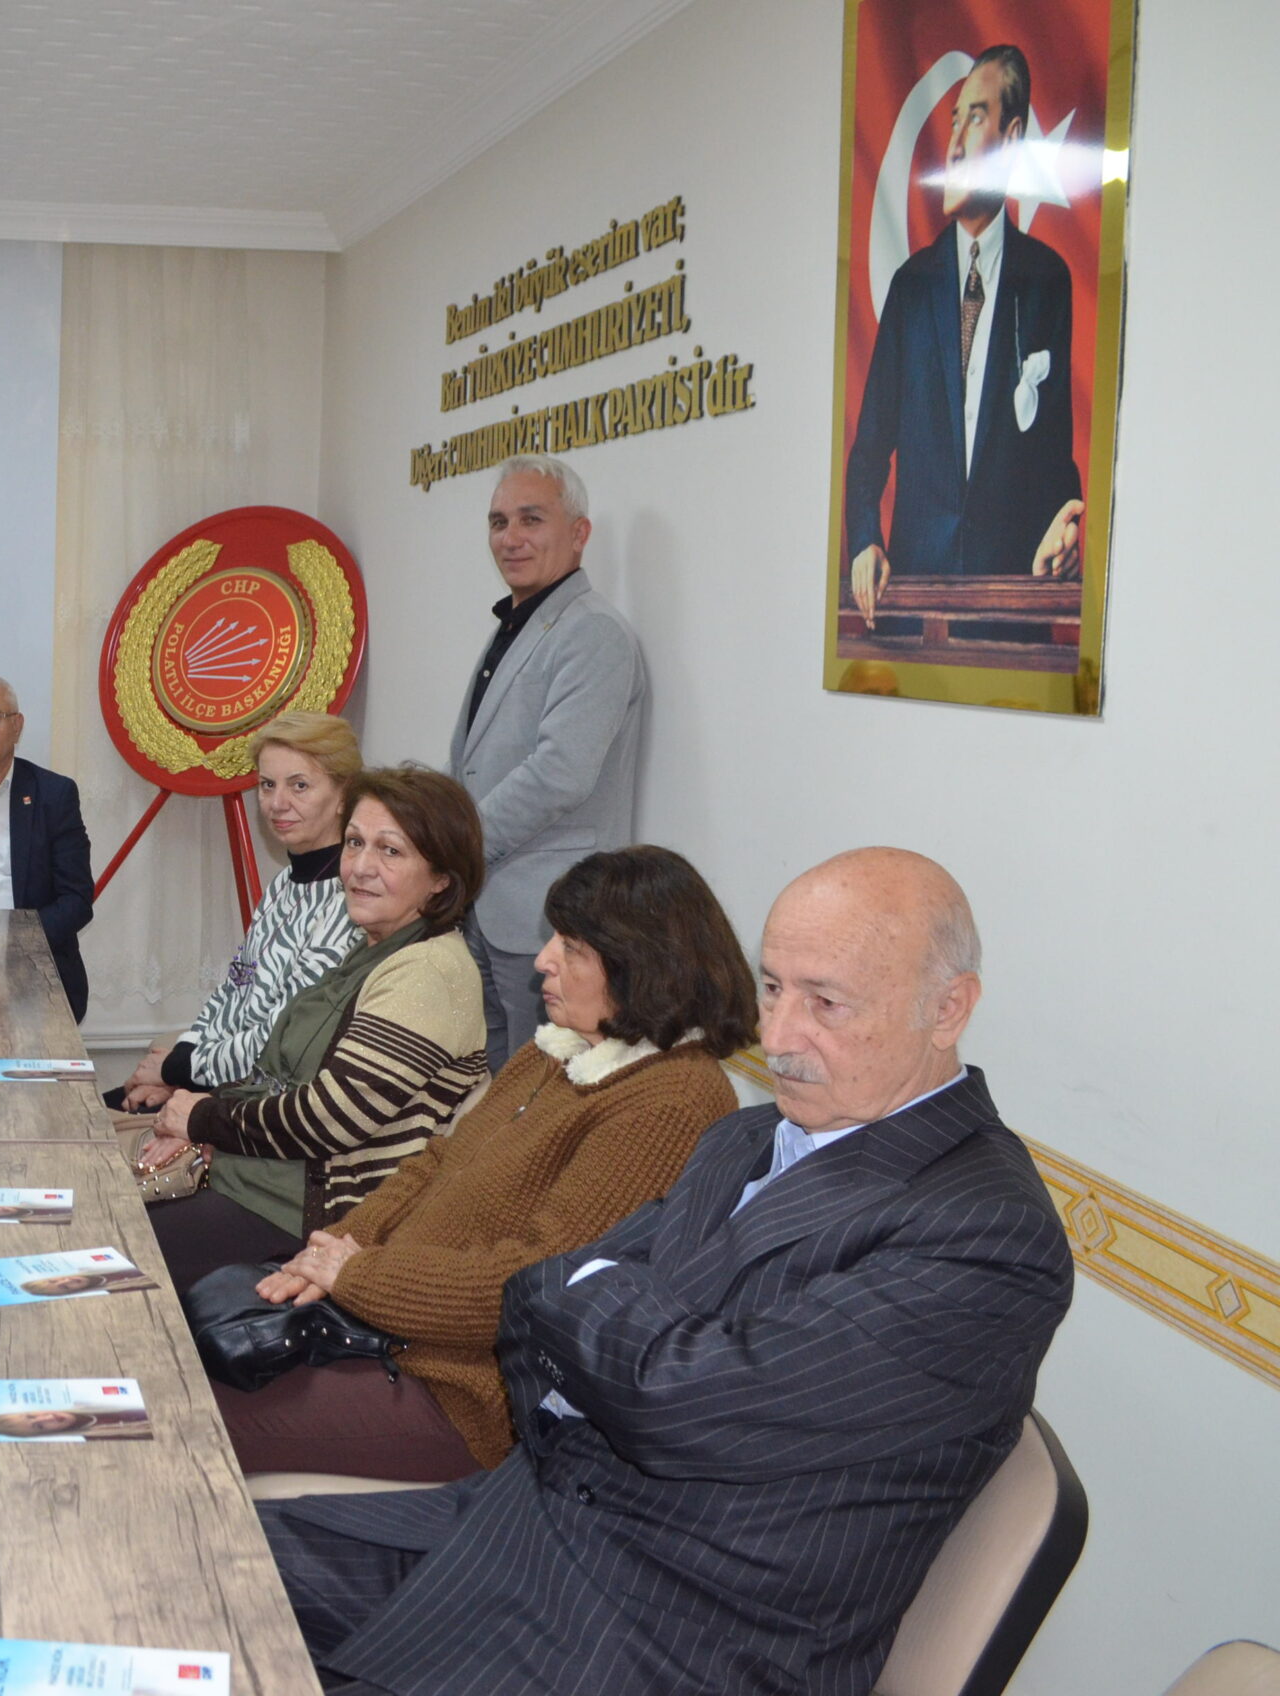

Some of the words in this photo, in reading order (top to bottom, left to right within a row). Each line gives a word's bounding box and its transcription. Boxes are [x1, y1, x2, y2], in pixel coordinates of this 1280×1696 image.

[446, 293, 492, 344] Benim
[493, 275, 515, 323] iki
[515, 245, 570, 313] büyük
[570, 219, 640, 286] eserim
[440, 366, 468, 412] Biri
[467, 331, 538, 404] TÜRKİYE
[410, 443, 449, 493] Diğeri
[447, 404, 549, 477] CUMHURİYET
[549, 391, 608, 453] HALK
[221, 580, 261, 595] CHP
[164, 622, 185, 698] POLATLI
[180, 692, 216, 718] İLÇE
[221, 625, 291, 717] BAŞKANLIĞI
